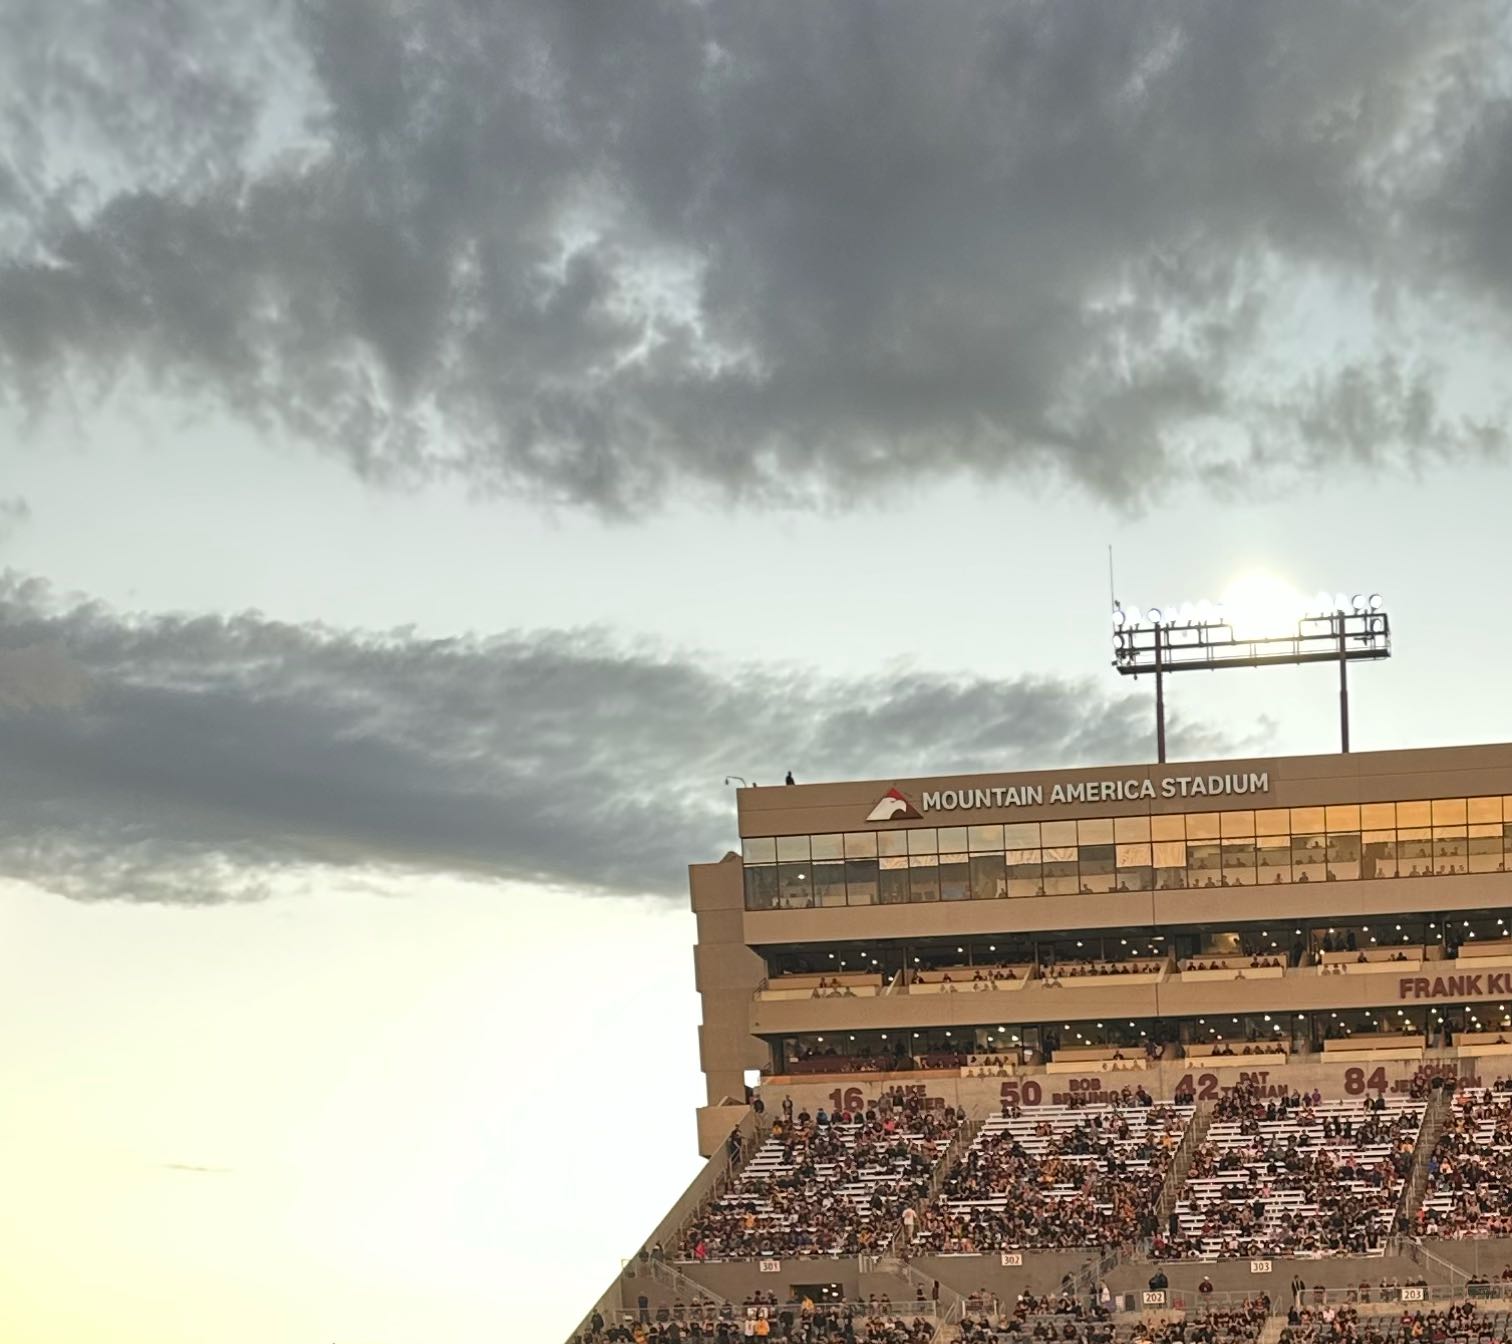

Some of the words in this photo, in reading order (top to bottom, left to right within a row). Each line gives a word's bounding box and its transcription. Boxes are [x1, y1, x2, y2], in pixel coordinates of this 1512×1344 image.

[922, 786, 1043, 811] MOUNTAIN
[1050, 779, 1156, 804] AMERICA
[1161, 772, 1269, 798] STADIUM
[1399, 974, 1484, 999] FRANK
[1069, 1078, 1101, 1092] BOB
[1175, 1073, 1218, 1100] 42
[1240, 1072, 1270, 1085] PAT
[1345, 1066, 1388, 1094] 84
[829, 1087, 864, 1113] 16
[1001, 1080, 1042, 1106] 50
[1146, 1293, 1162, 1302] 202
